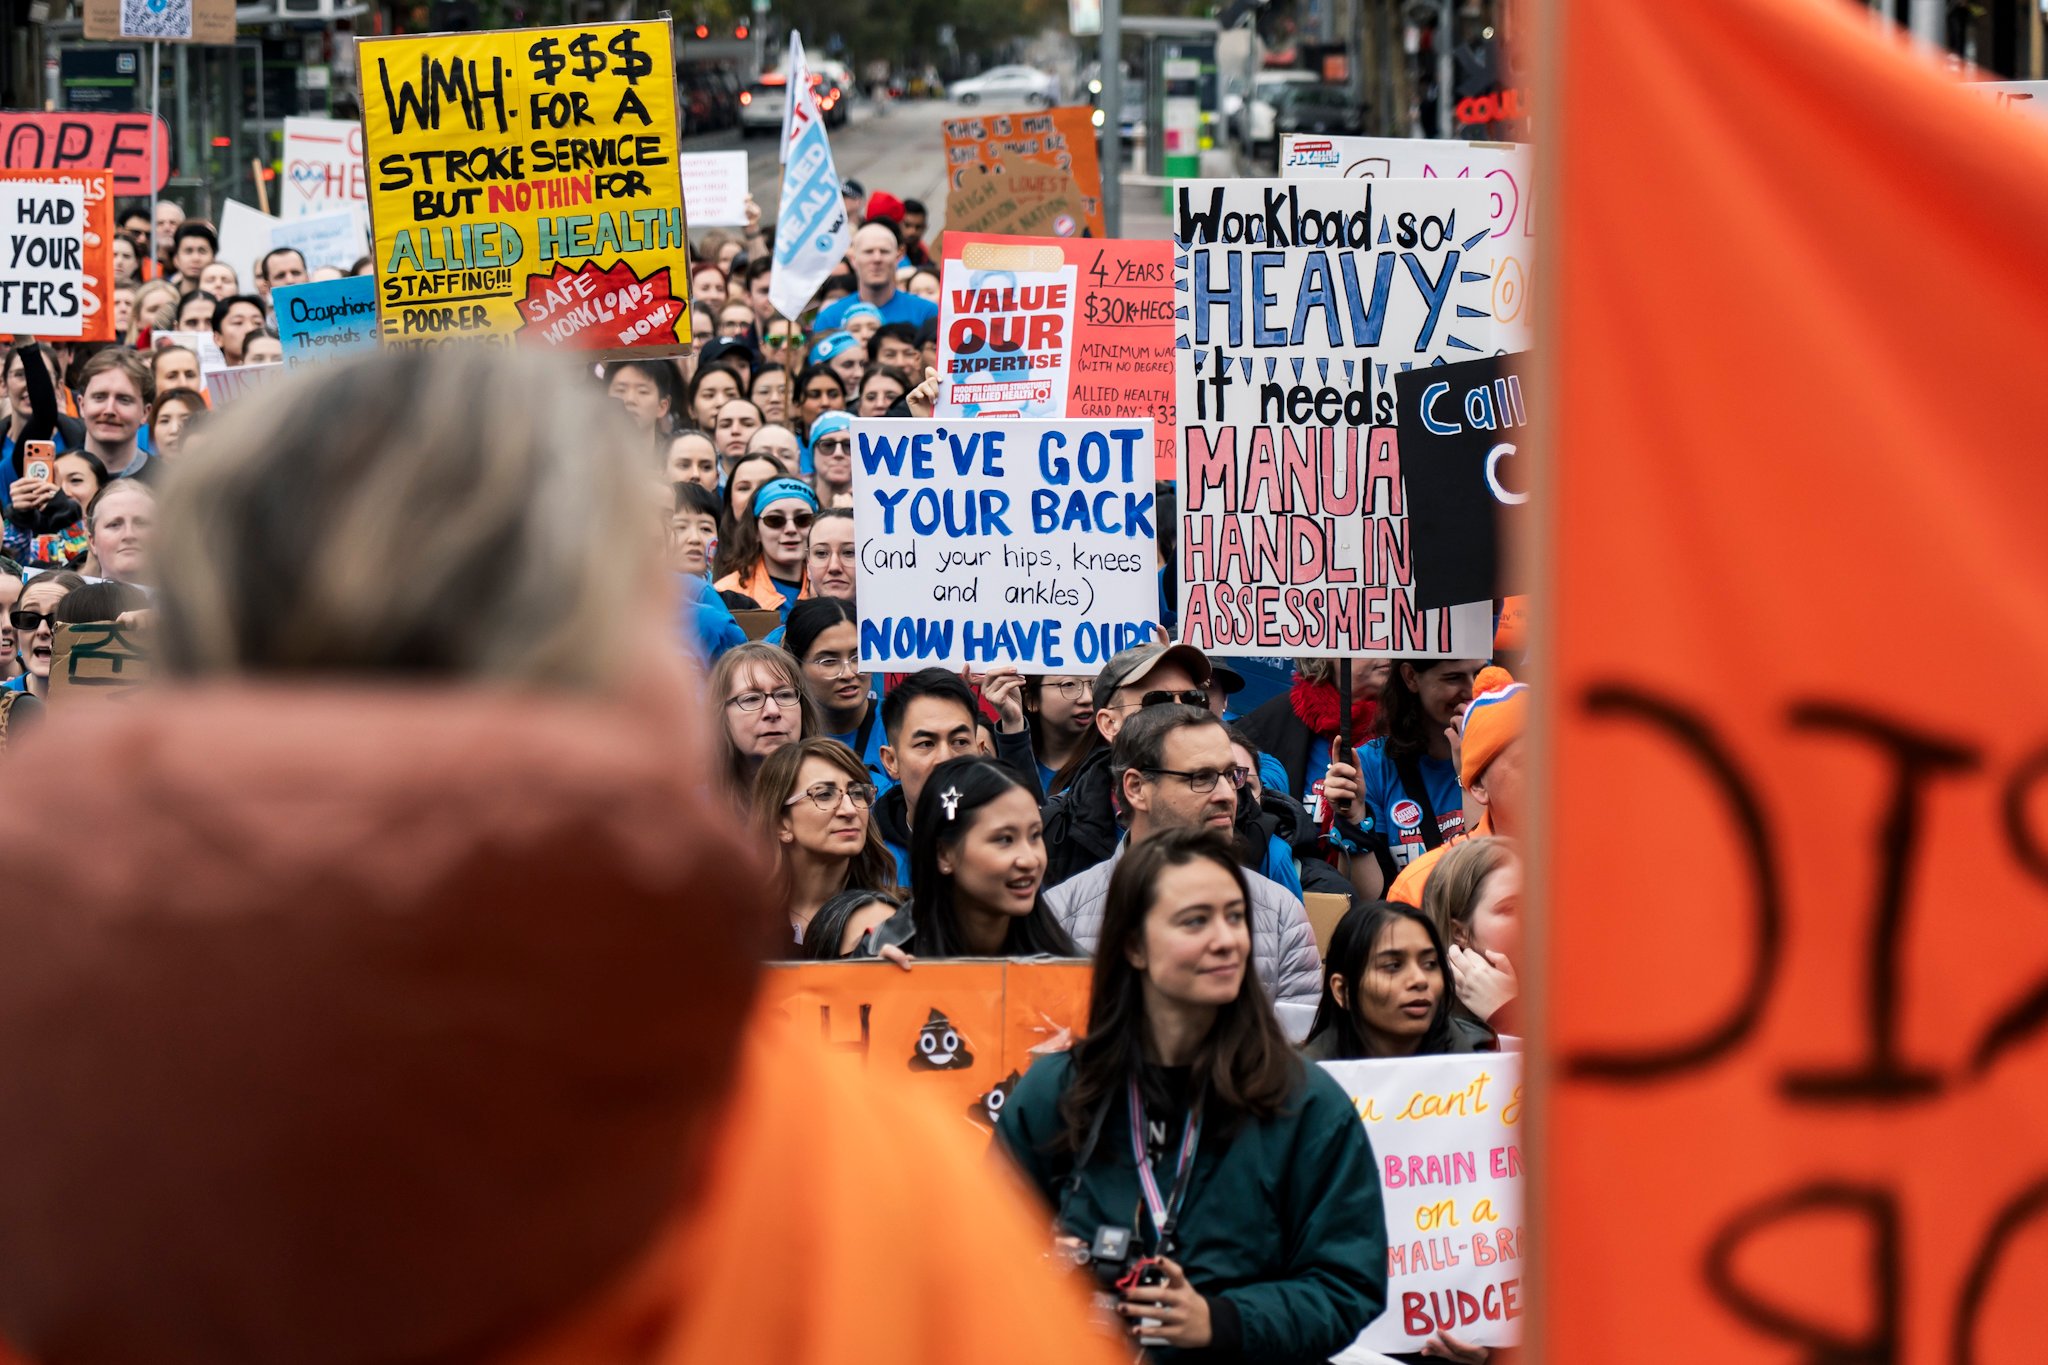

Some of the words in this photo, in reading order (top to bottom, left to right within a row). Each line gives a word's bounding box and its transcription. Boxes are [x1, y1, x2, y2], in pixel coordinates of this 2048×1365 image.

[528, 29, 652, 85] $$$
[530, 91, 595, 129] FOR
[613, 87, 653, 126] A
[379, 146, 524, 191] STROKE
[532, 134, 669, 172] SERVICE
[18, 198, 75, 225] HAD
[413, 188, 483, 221] BUT
[594, 171, 652, 200] FOR
[387, 222, 524, 274] ALLIED
[538, 207, 683, 261] HEALTH
[1396, 211, 1445, 251] so
[10, 235, 82, 270] YOUR
[1089, 249, 1109, 288] 4
[1114, 258, 1164, 285] YEARS
[0, 280, 80, 318] FERS
[383, 269, 513, 300] STAFFING!!!
[530, 273, 598, 322] SAFE
[951, 284, 1067, 314] VALUE
[1193, 249, 1460, 352] HEAVY
[403, 304, 491, 335] POORER
[541, 282, 654, 346] WORKLOADS
[617, 304, 674, 346] NOW!
[948, 314, 1064, 354] OUR
[947, 354, 1061, 374] EXPERTISE
[1077, 358, 1113, 374] (WITH
[1116, 361, 1131, 372] NO
[1134, 361, 1174, 375] DEGREE)
[1080, 343, 1150, 360] MINIMUM
[953, 392, 971, 403] FOR
[972, 391, 1001, 402] ALLIED
[1001, 389, 1034, 401] HEALTH
[954, 384, 982, 394] MODERN
[1072, 384, 1119, 402] ALLIED
[1123, 389, 1170, 403] HEALTH
[1196, 345, 1233, 421] it
[1260, 357, 1398, 427] needs
[1081, 403, 1111, 416] GRAD
[1116, 404, 1142, 418] PAY:
[1147, 403, 1176, 426] $33
[858, 427, 1006, 480] WE'VE
[1038, 428, 1144, 486] GOT
[1185, 425, 1403, 516] MANUA
[1484, 443, 1531, 505] C
[873, 487, 1014, 538] YOUR
[1031, 488, 1155, 539] BACK
[861, 537, 917, 575] (and
[935, 549, 992, 573] your
[1003, 543, 1062, 577] hips,
[1073, 542, 1142, 573] knees
[1184, 513, 1412, 587] HANDLIN
[933, 576, 978, 603] and
[1004, 576, 1095, 616] ankles)
[860, 616, 954, 661] NOW
[963, 618, 1064, 667] HAVE
[1396, 1072, 1491, 1121] can't
[1384, 1151, 1477, 1189] BRAIN
[1490, 1145, 1525, 1180] EN
[1415, 1196, 1460, 1231] on
[1472, 1195, 1500, 1224] a
[1402, 1278, 1523, 1336] BUDGE
